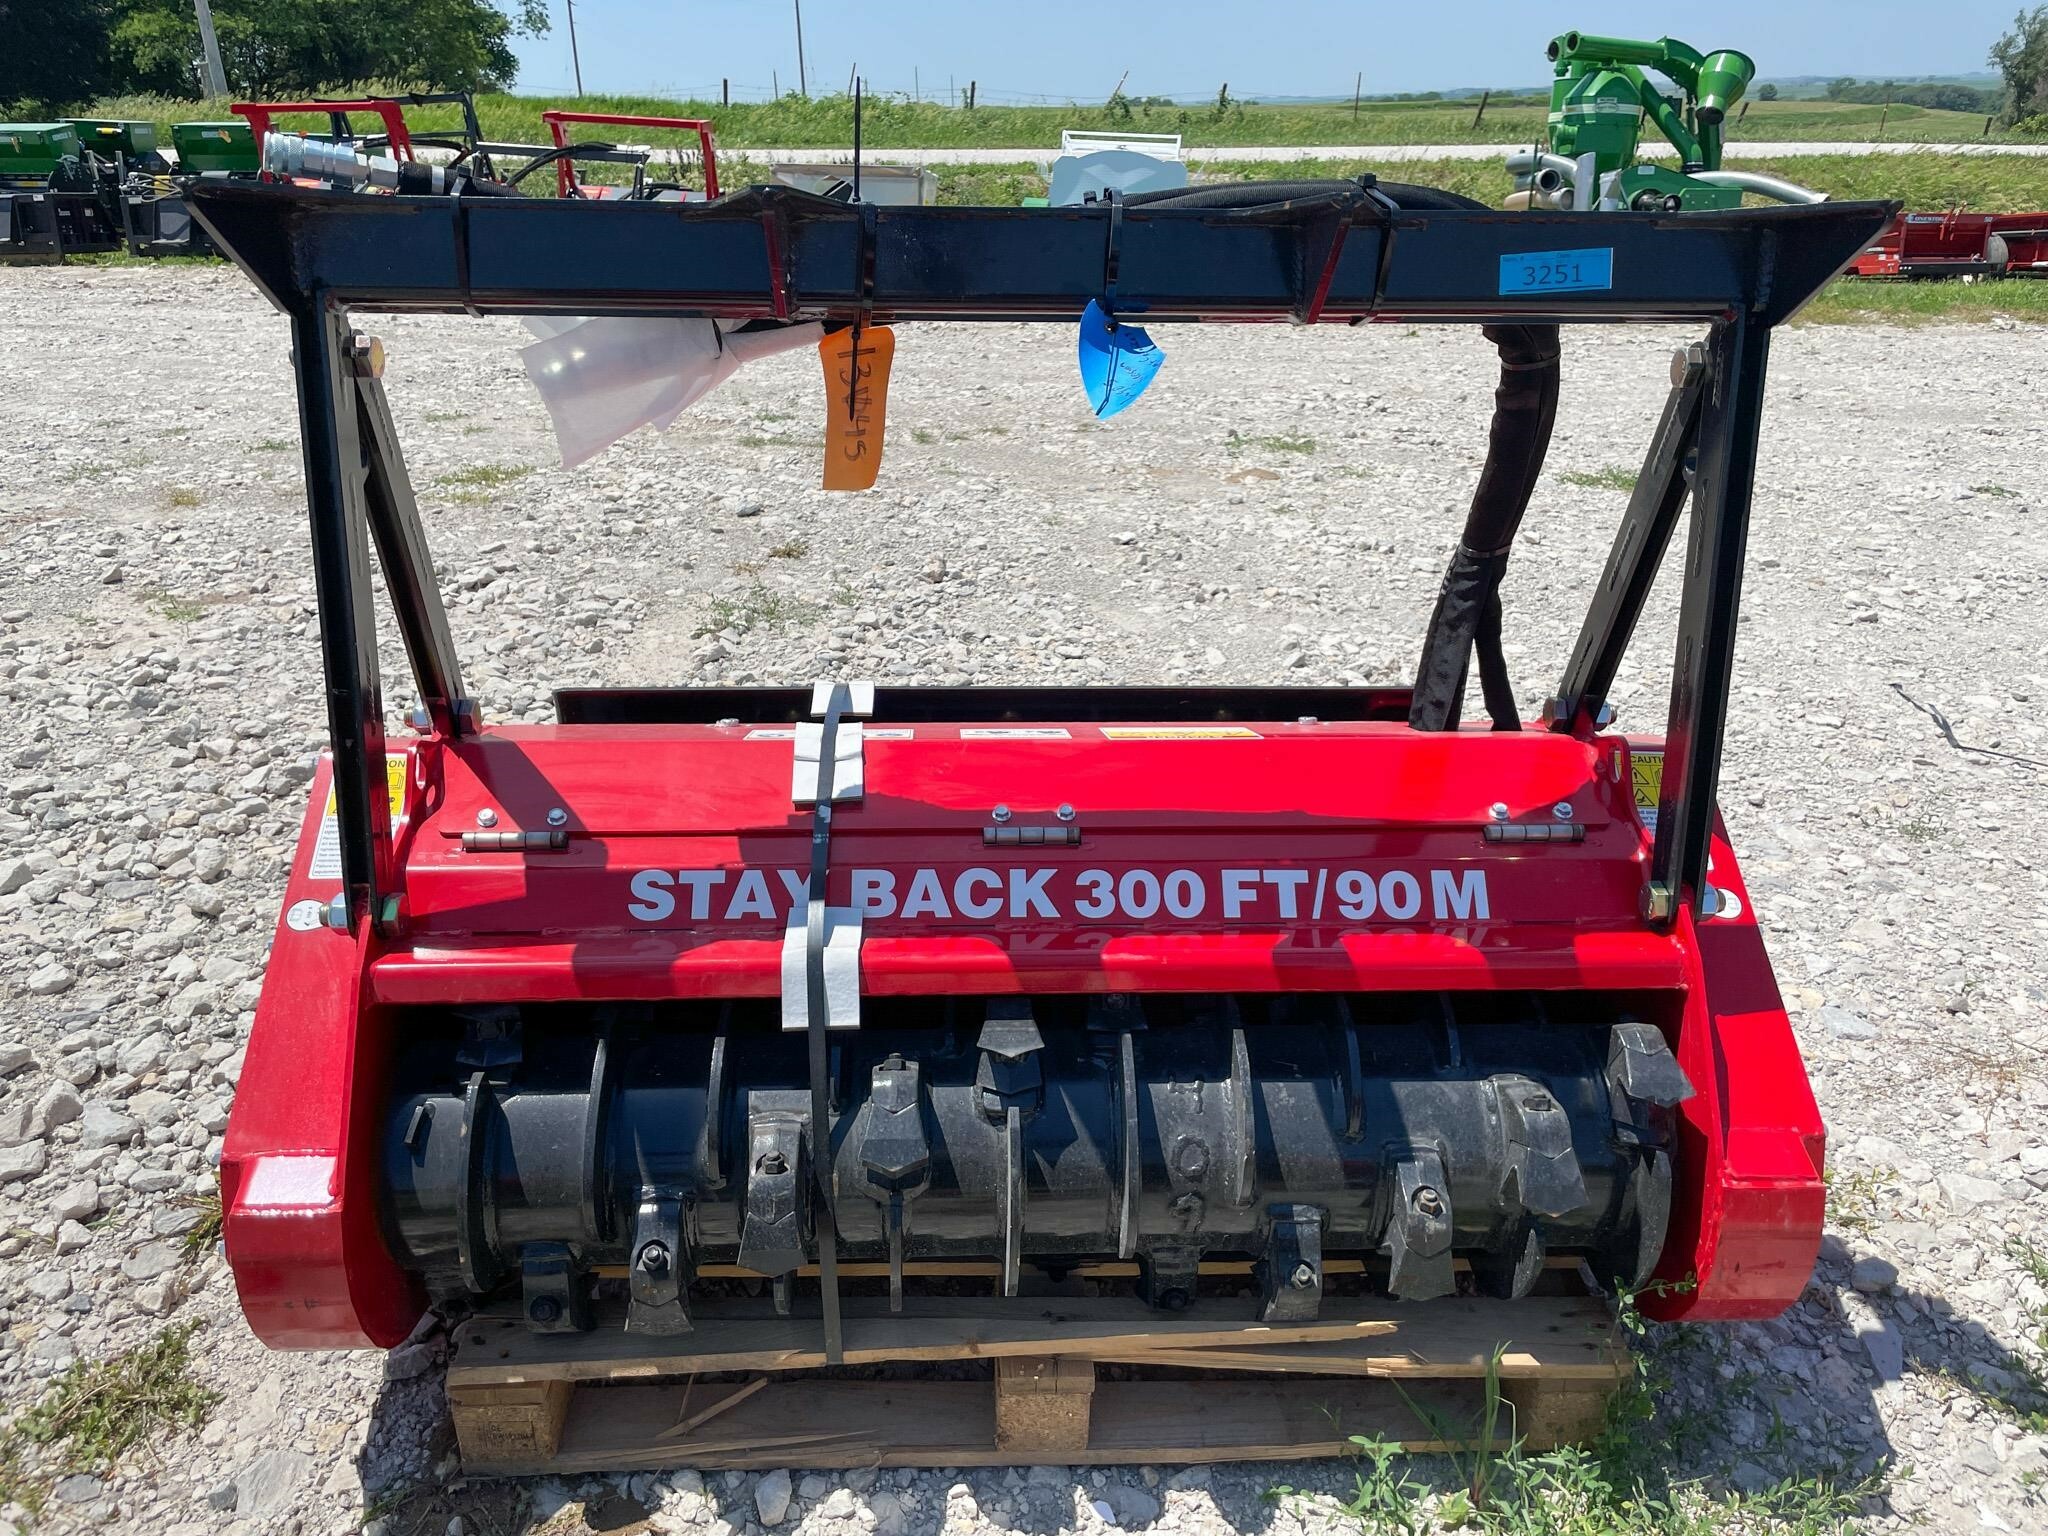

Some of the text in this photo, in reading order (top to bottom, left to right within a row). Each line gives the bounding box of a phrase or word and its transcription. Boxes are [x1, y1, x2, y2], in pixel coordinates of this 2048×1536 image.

[1522, 263, 1583, 286] 3251
[1631, 755, 1665, 765] CAUTI
[851, 868, 1061, 920] BACK
[1074, 868, 1206, 920] 300
